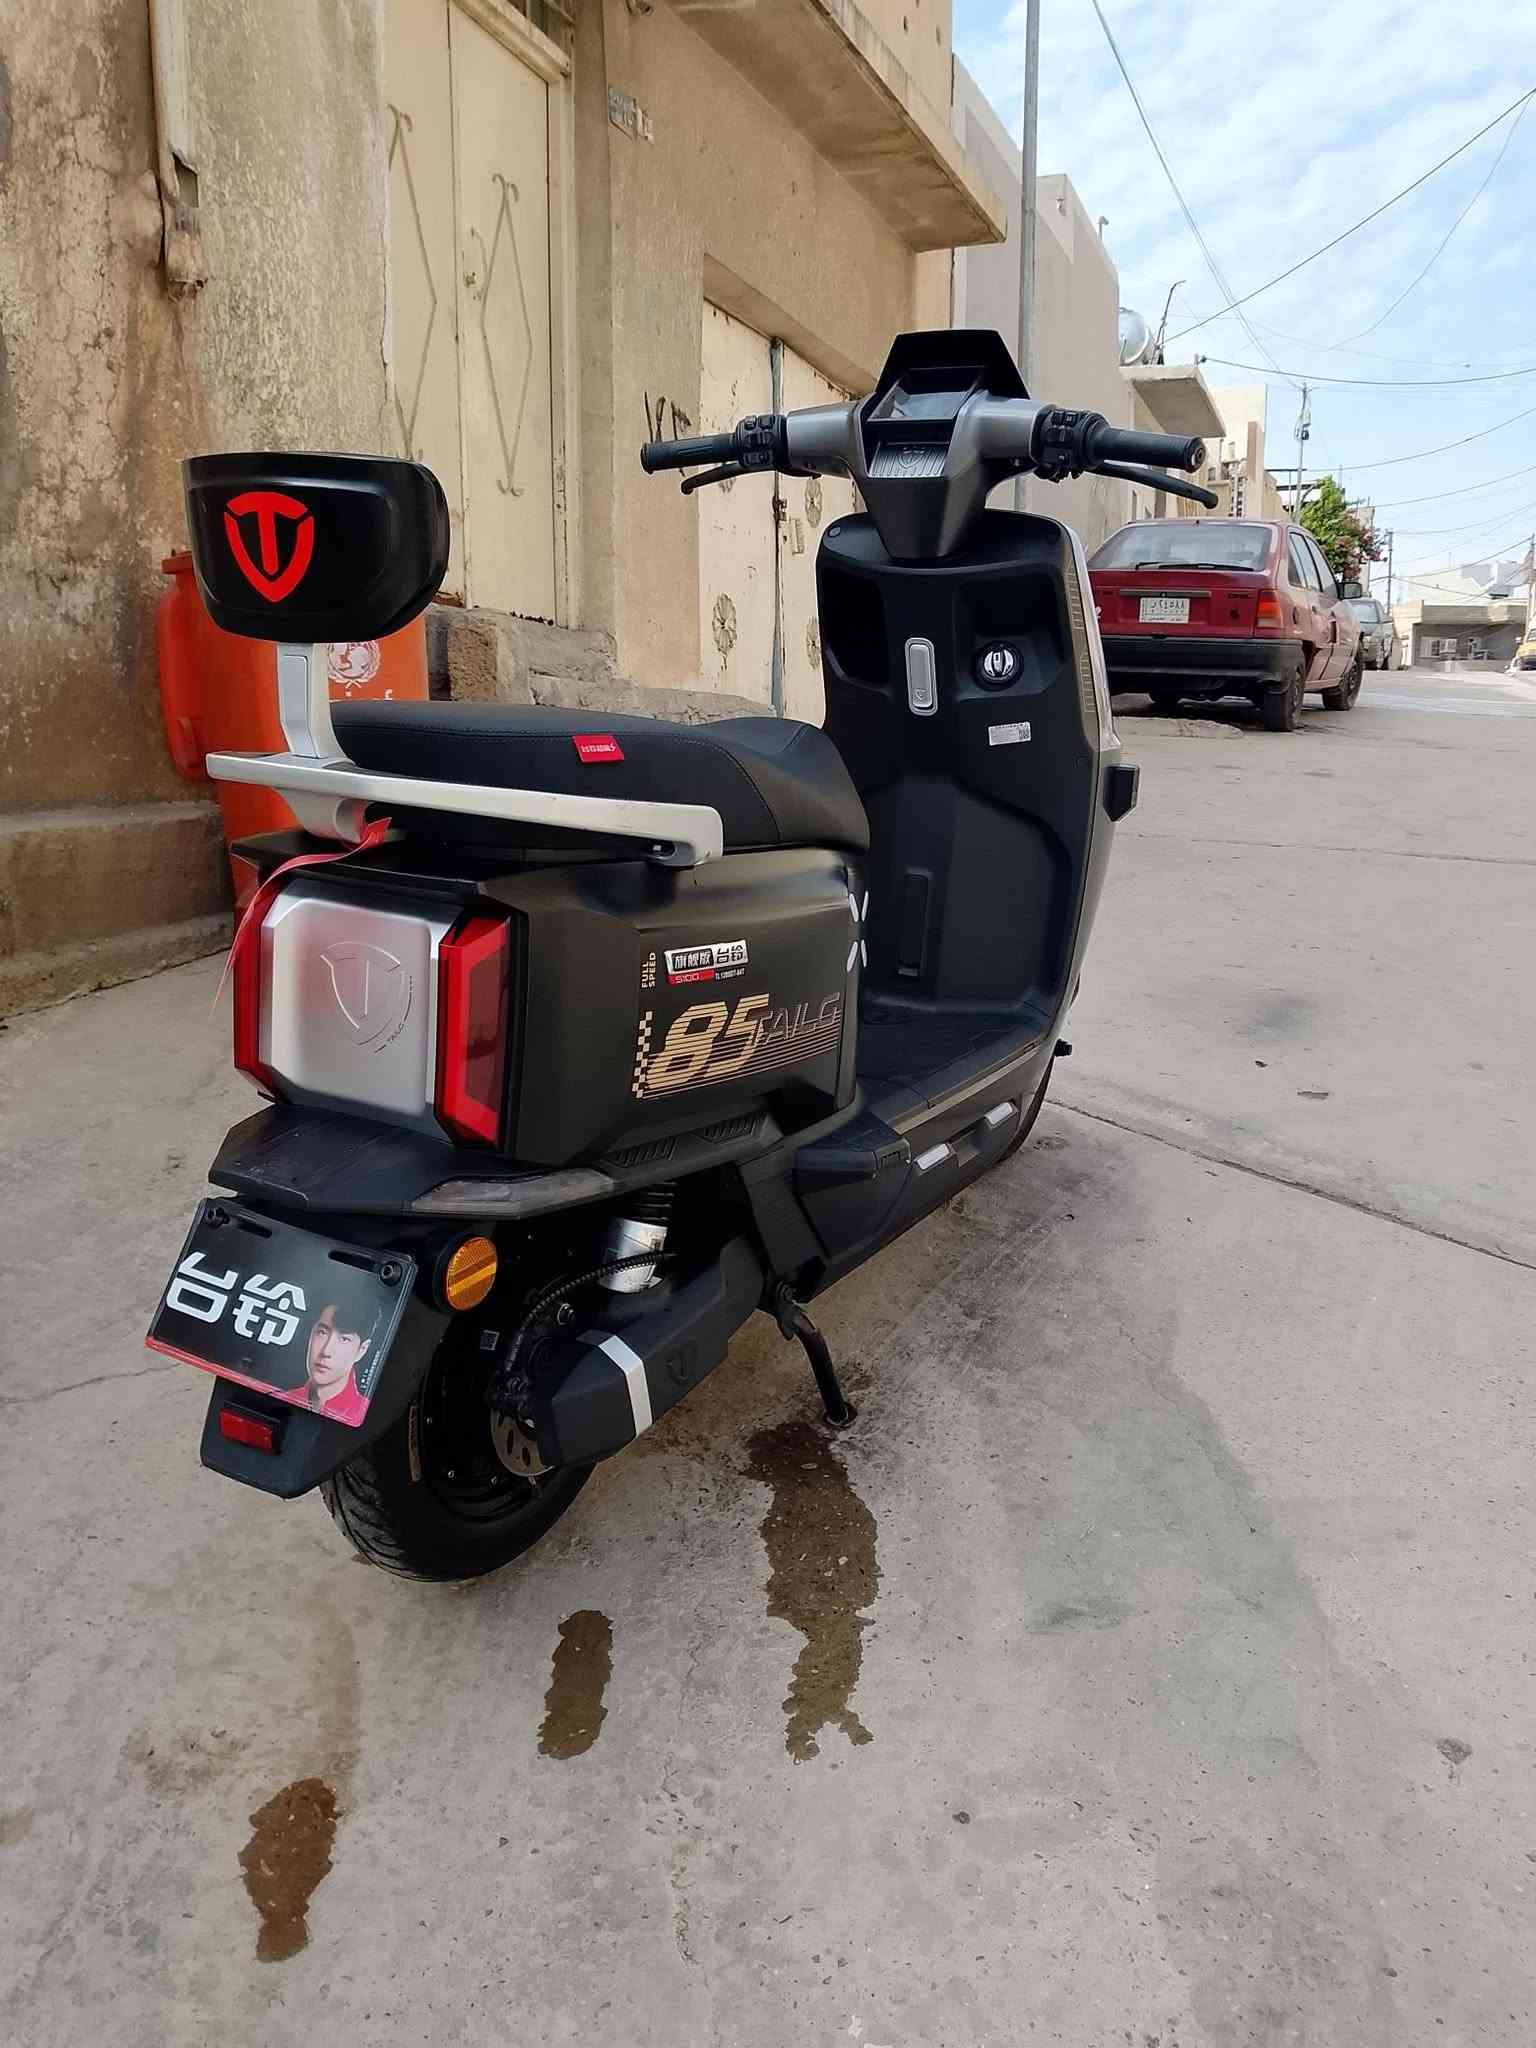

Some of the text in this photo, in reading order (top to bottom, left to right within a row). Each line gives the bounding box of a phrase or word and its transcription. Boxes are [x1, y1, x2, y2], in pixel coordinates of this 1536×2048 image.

[641, 961, 649, 988] FULL
[648, 952, 657, 988] SPEED
[646, 993, 841, 1093] 85 TAILG
[166, 1251, 307, 1346] 台铃
